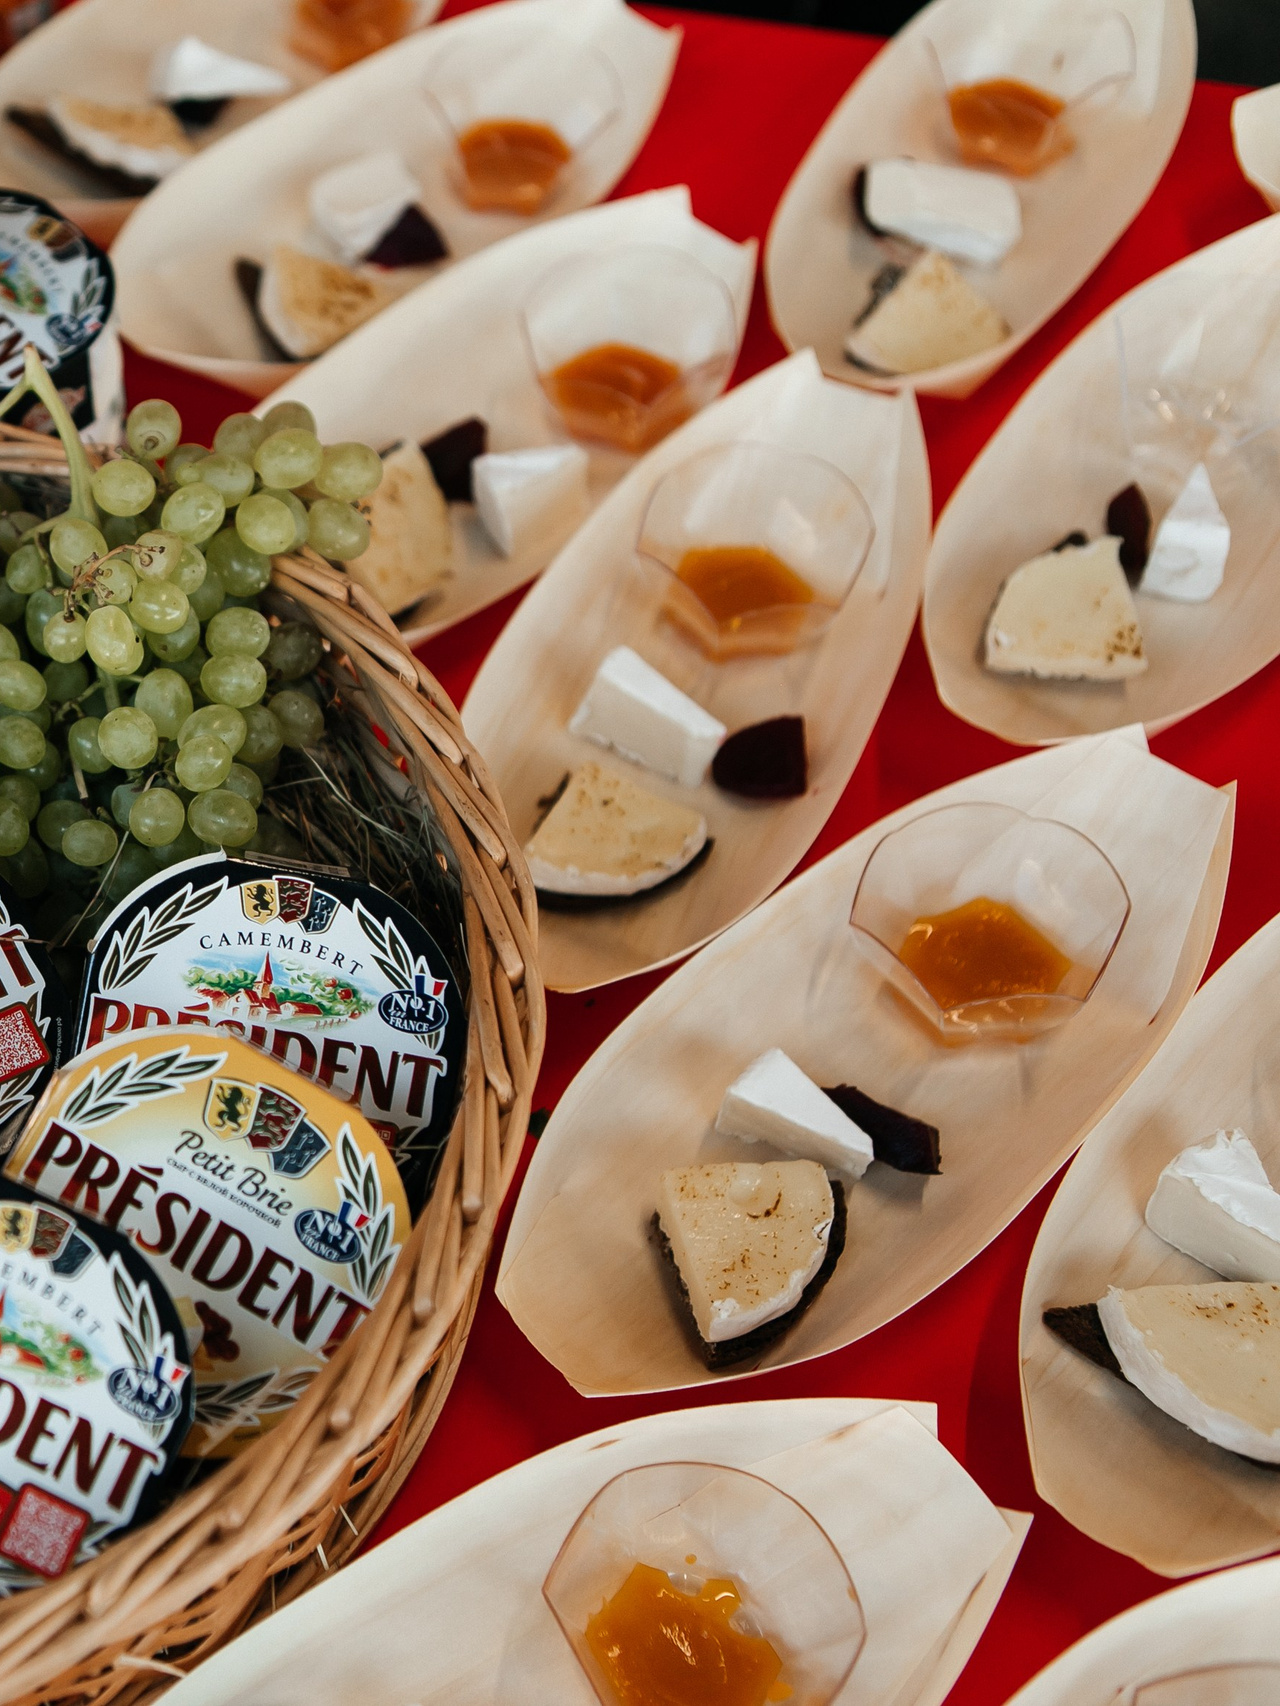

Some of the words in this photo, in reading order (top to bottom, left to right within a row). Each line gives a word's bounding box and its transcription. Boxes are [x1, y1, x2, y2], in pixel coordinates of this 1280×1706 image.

[198, 930, 365, 977] CAMEMBERT
[389, 1016, 430, 1033] FRANCE
[174, 1129, 235, 1182] Petit
[236, 1166, 294, 1216] Brie
[22, 1121, 374, 1360] PRÉSIDENT
